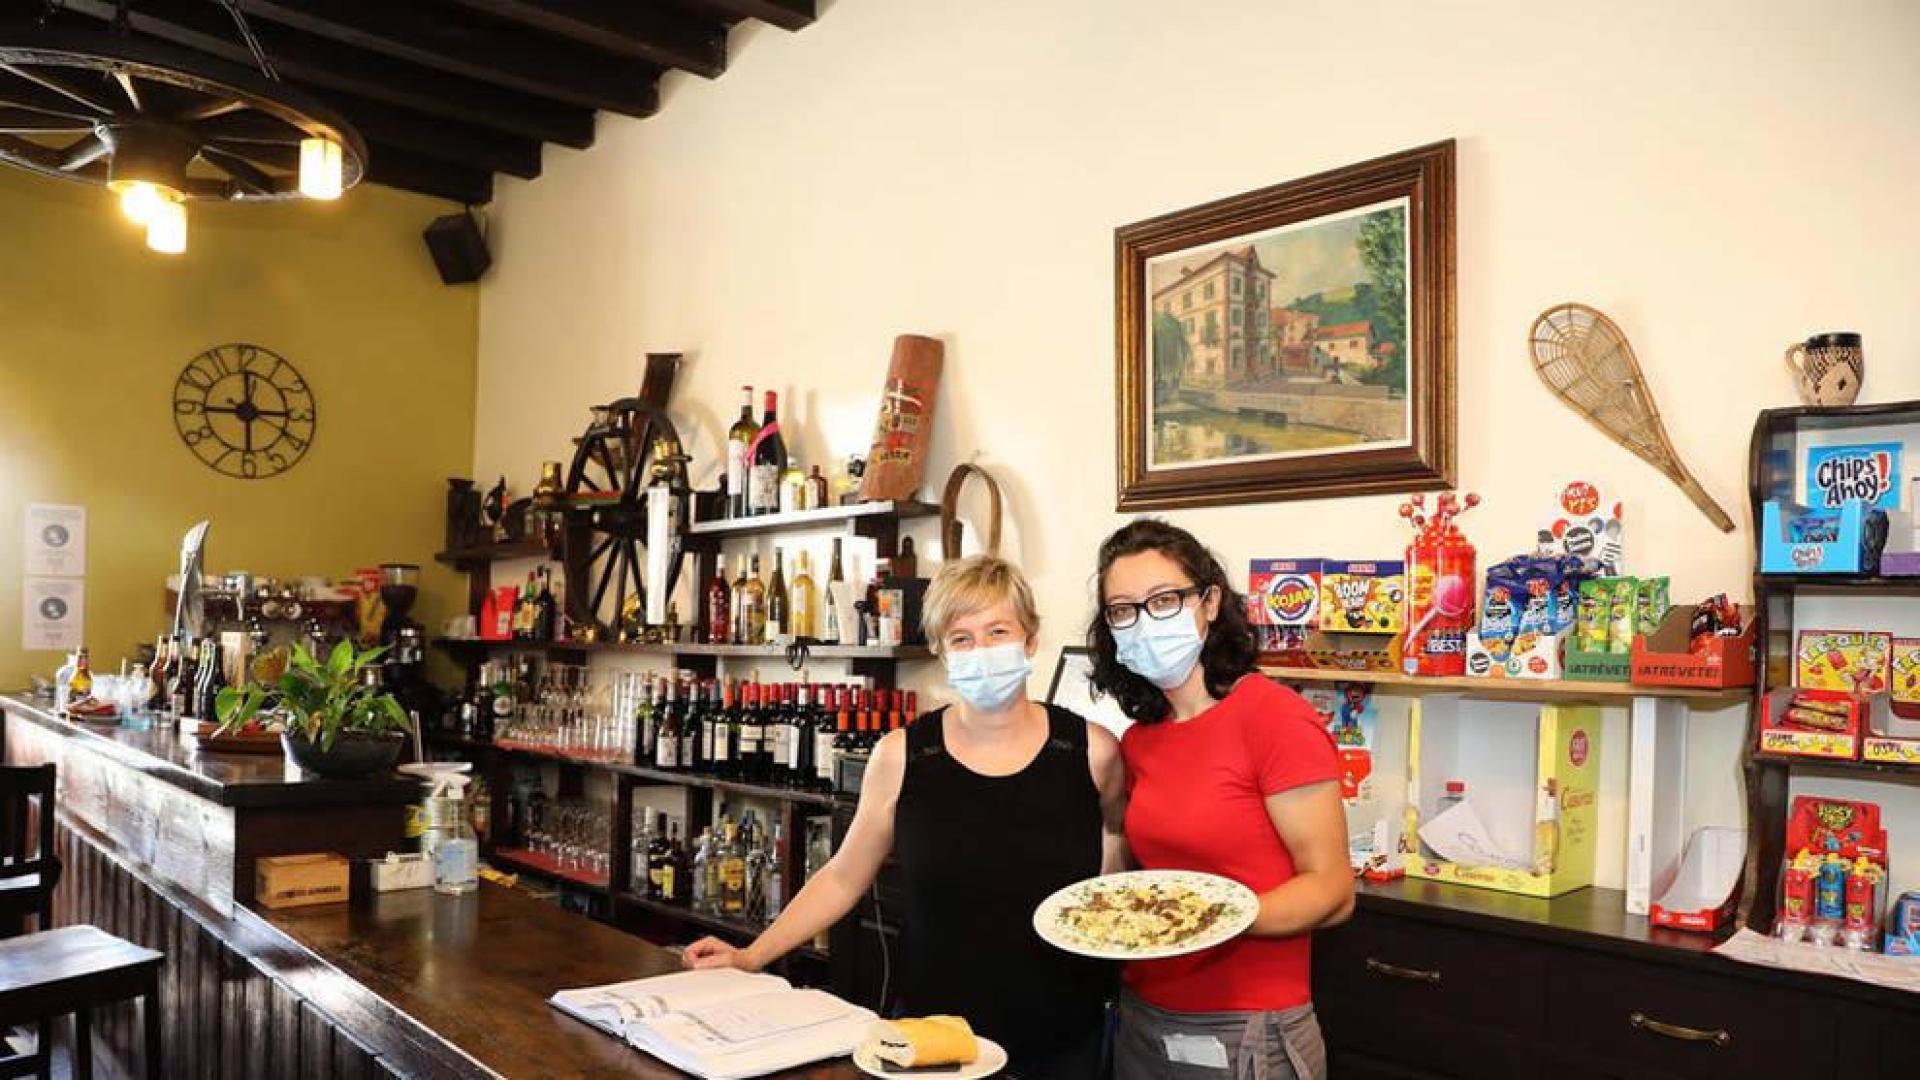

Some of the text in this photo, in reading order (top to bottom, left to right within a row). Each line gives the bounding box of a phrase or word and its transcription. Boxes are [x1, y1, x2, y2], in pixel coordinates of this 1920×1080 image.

[1817, 457, 1876, 488] Chips
[1266, 588, 1314, 608] KOJAK
[1570, 663, 1631, 676] ¡ATRÉVET
